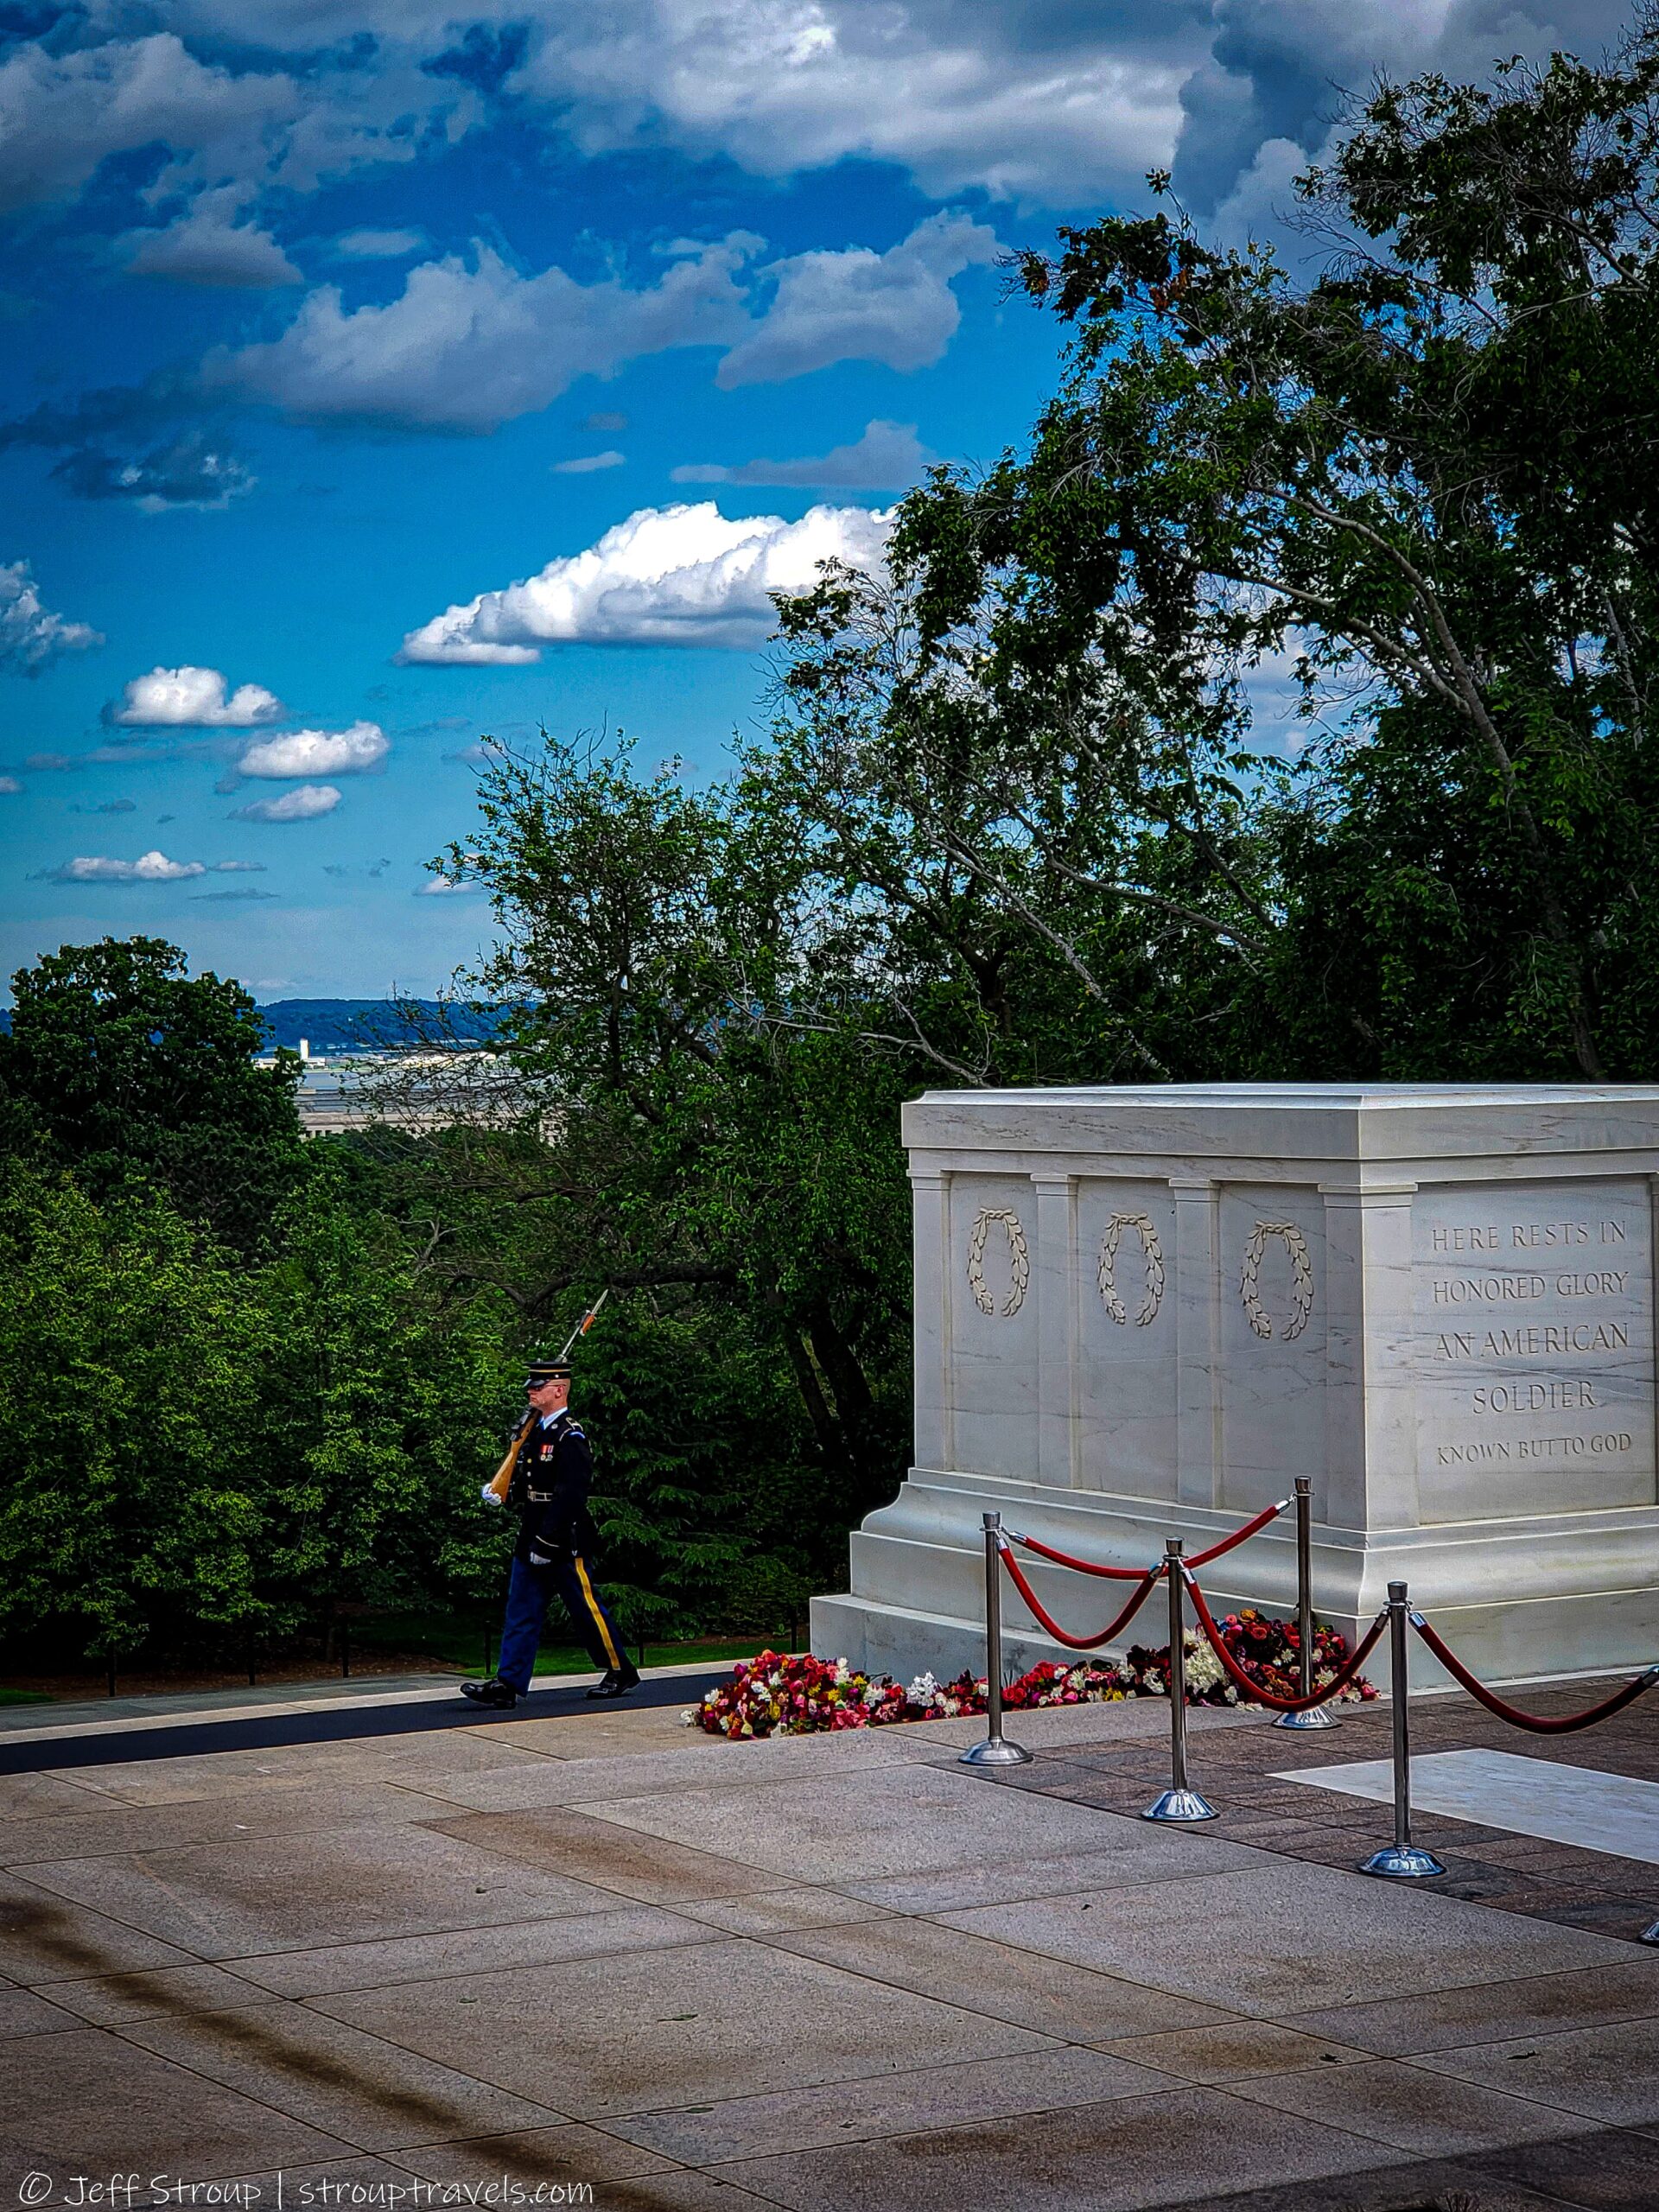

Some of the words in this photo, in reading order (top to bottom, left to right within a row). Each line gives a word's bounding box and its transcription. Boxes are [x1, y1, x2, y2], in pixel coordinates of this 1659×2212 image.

[1433, 1227, 1498, 1250] HERE
[1512, 1223, 1588, 1248] RESTS
[1600, 1220, 1626, 1243] IN
[1433, 1276, 1546, 1303] HONORED
[1556, 1271, 1630, 1296] GLORY
[1433, 1332, 1472, 1359] AN
[1480, 1323, 1629, 1357] AMERICAN
[1473, 1381, 1597, 1414] SOLDIER
[1437, 1442, 1510, 1465] KNOWN
[1518, 1439, 1554, 1459] BUT
[1555, 1437, 1585, 1455] TO
[1591, 1433, 1631, 1453] GOD
